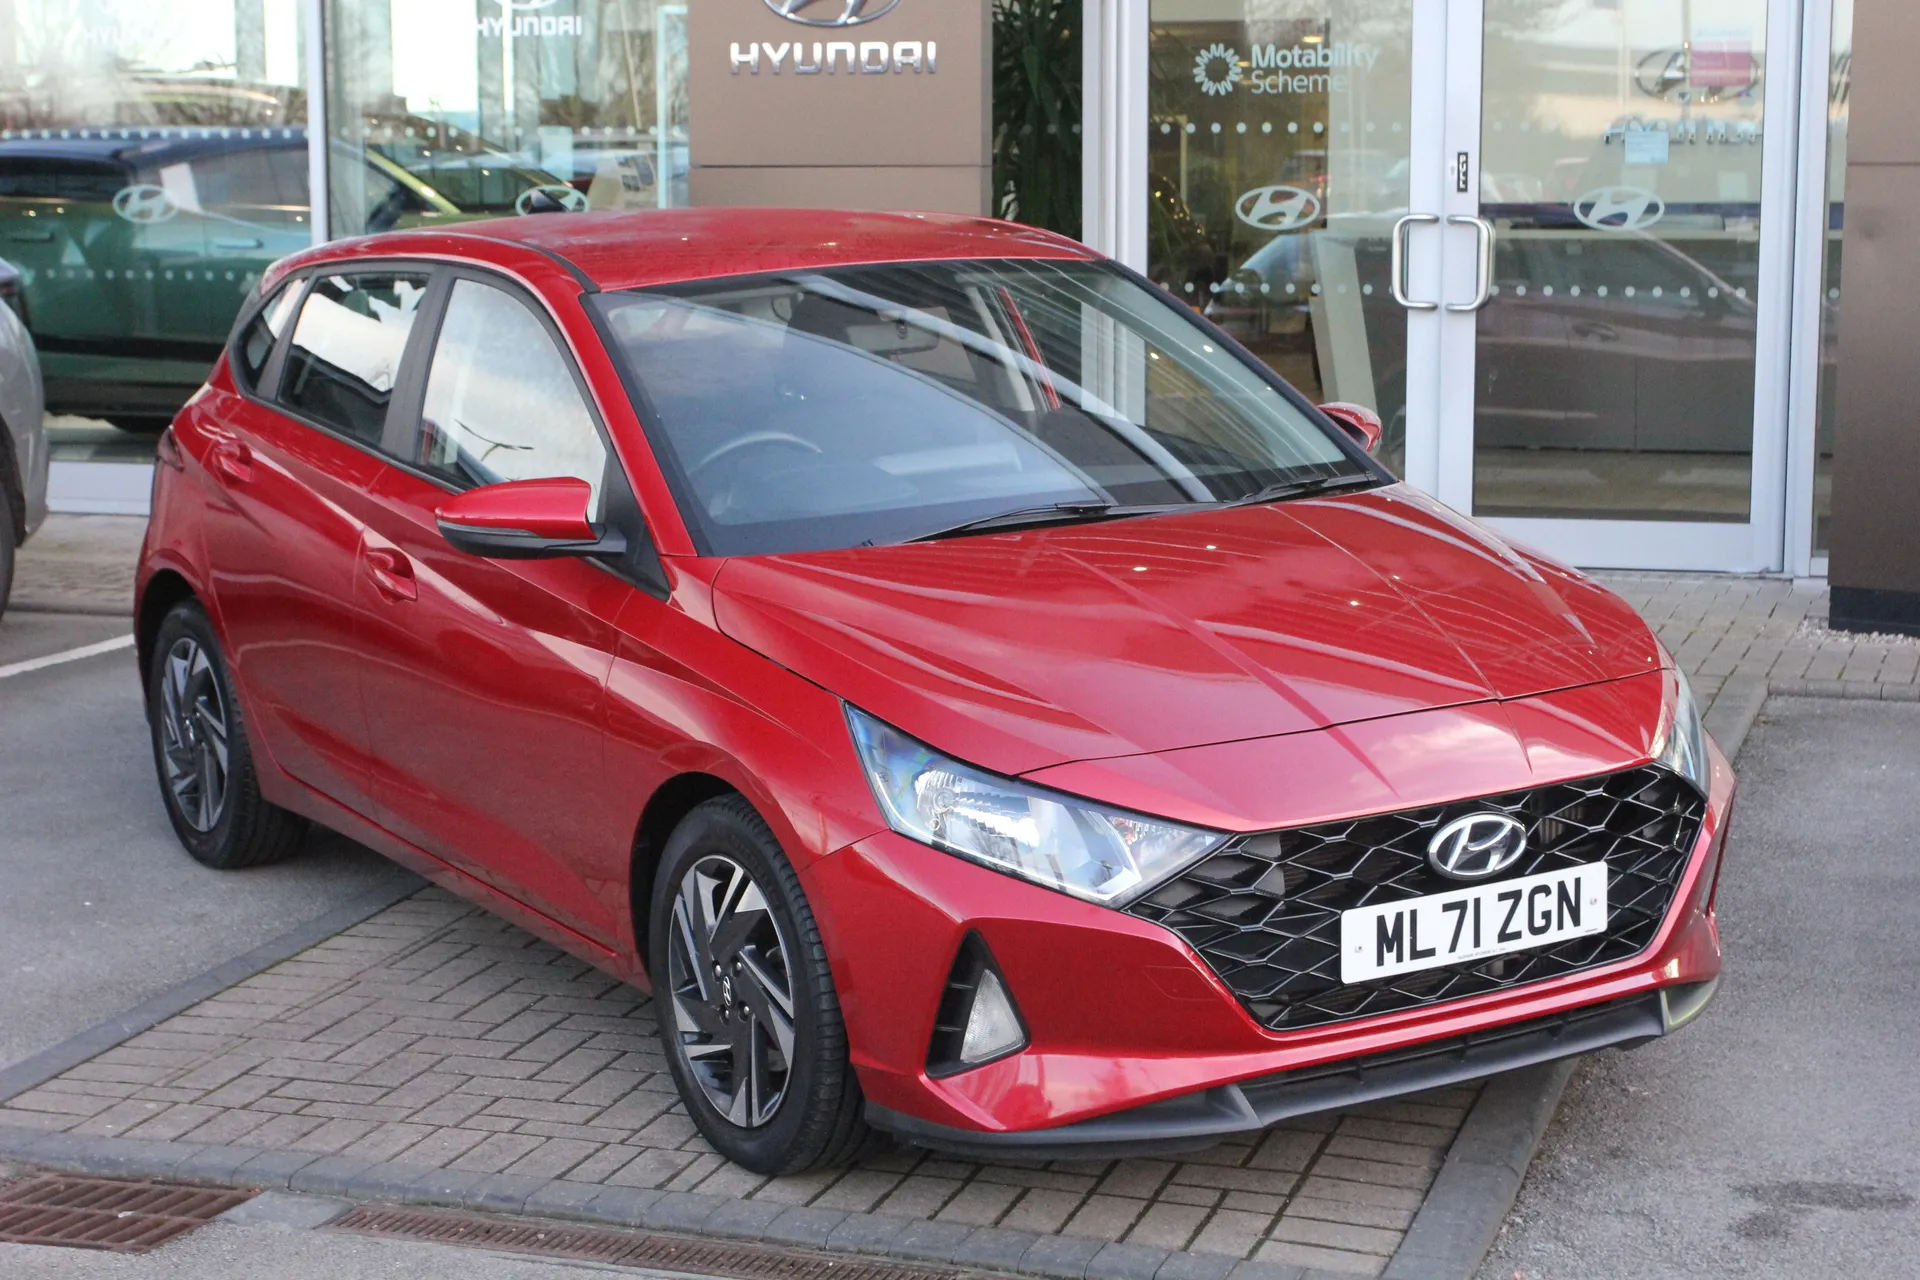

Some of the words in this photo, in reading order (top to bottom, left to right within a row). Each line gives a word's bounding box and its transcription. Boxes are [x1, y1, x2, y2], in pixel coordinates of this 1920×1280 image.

[474, 15, 582, 37] HYUNDAI
[730, 41, 937, 75] HYUNDAI
[1251, 43, 1380, 73] Motability
[1251, 70, 1348, 95] Scheme
[1376, 897, 1481, 967] ML71
[1497, 877, 1581, 944] ZGN
